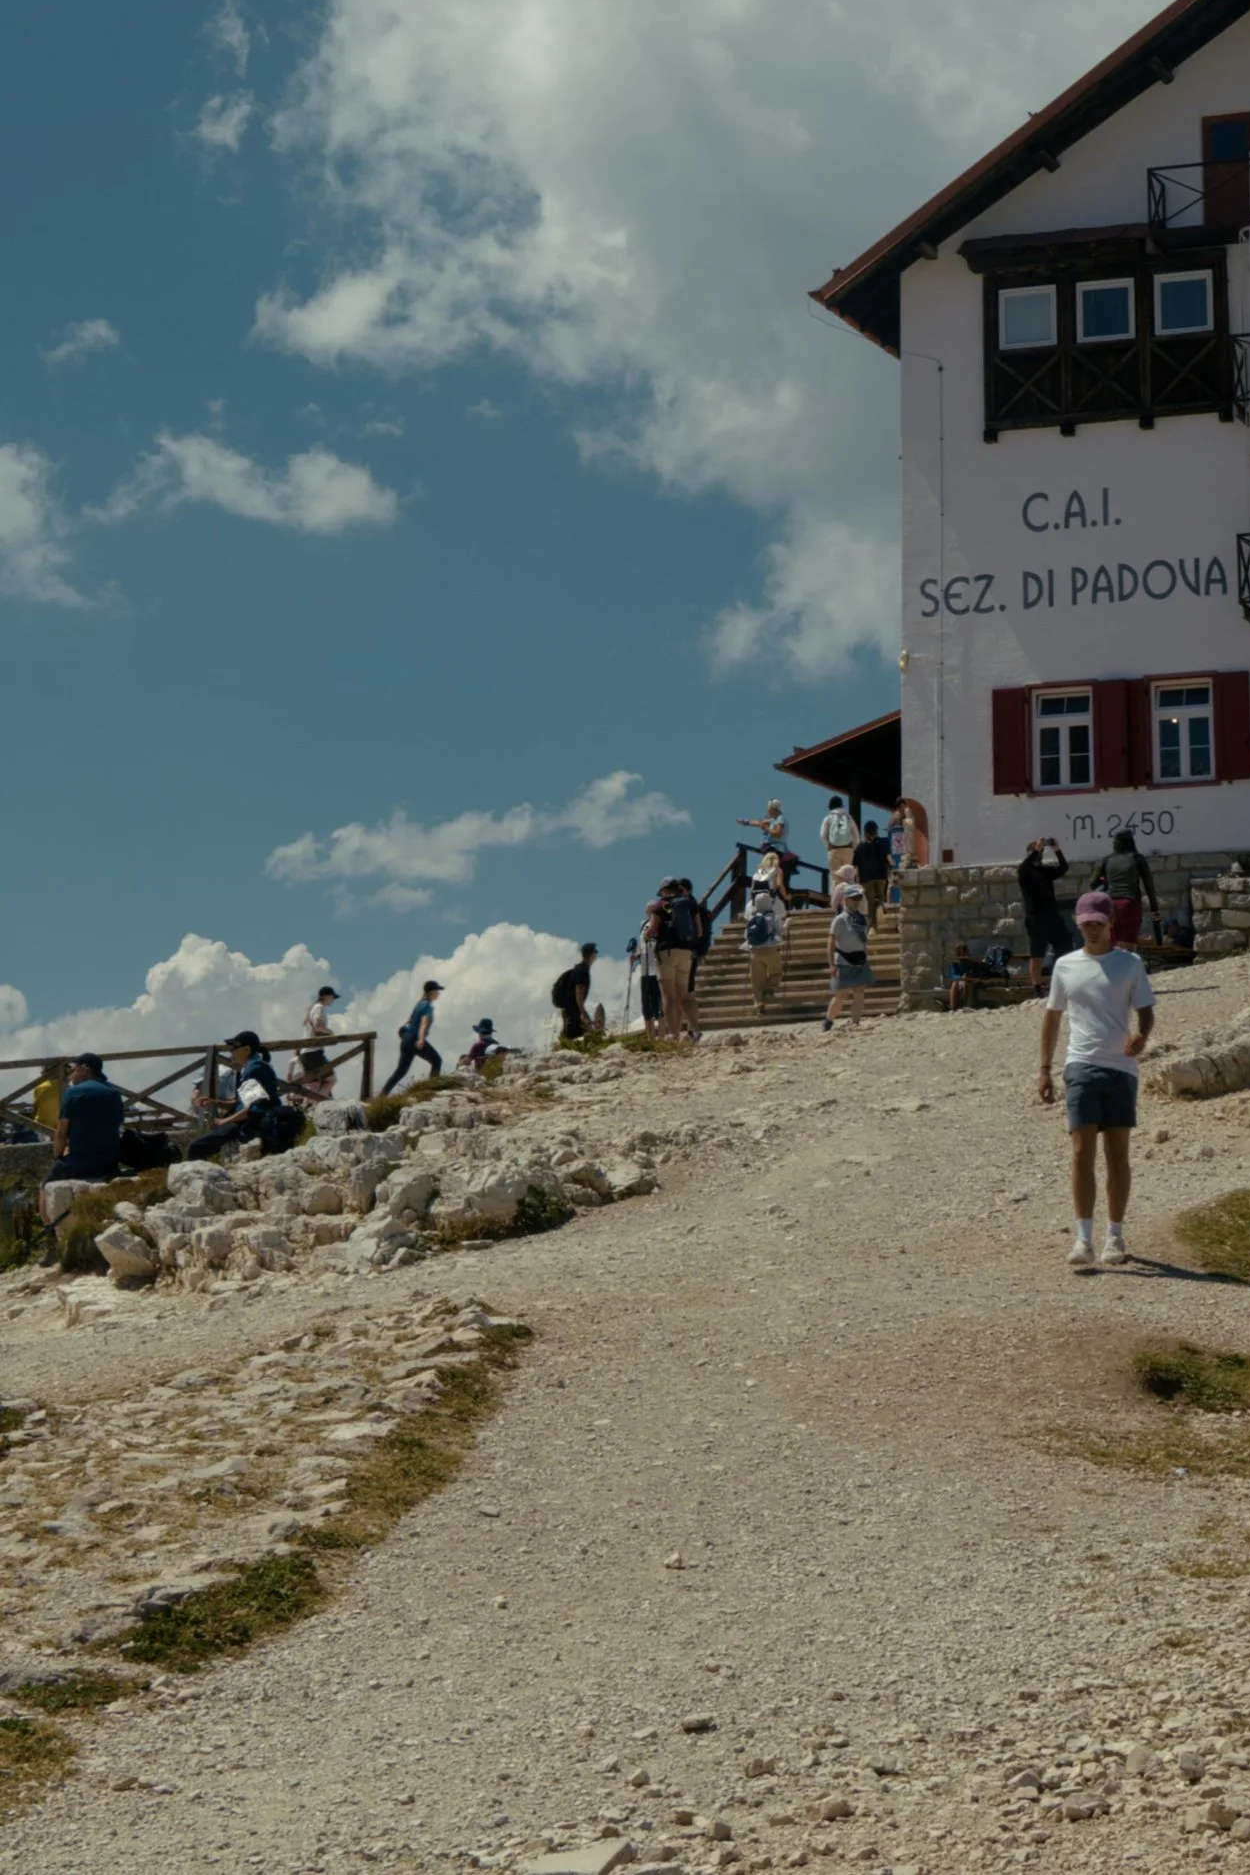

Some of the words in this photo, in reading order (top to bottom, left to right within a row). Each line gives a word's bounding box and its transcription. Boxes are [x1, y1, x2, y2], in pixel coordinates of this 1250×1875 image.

[1022, 487, 1123, 533] C.A.I.
[919, 574, 1007, 618] SEZ.
[1022, 569, 1055, 610] DI
[1071, 556, 1228, 606] PADOVA
